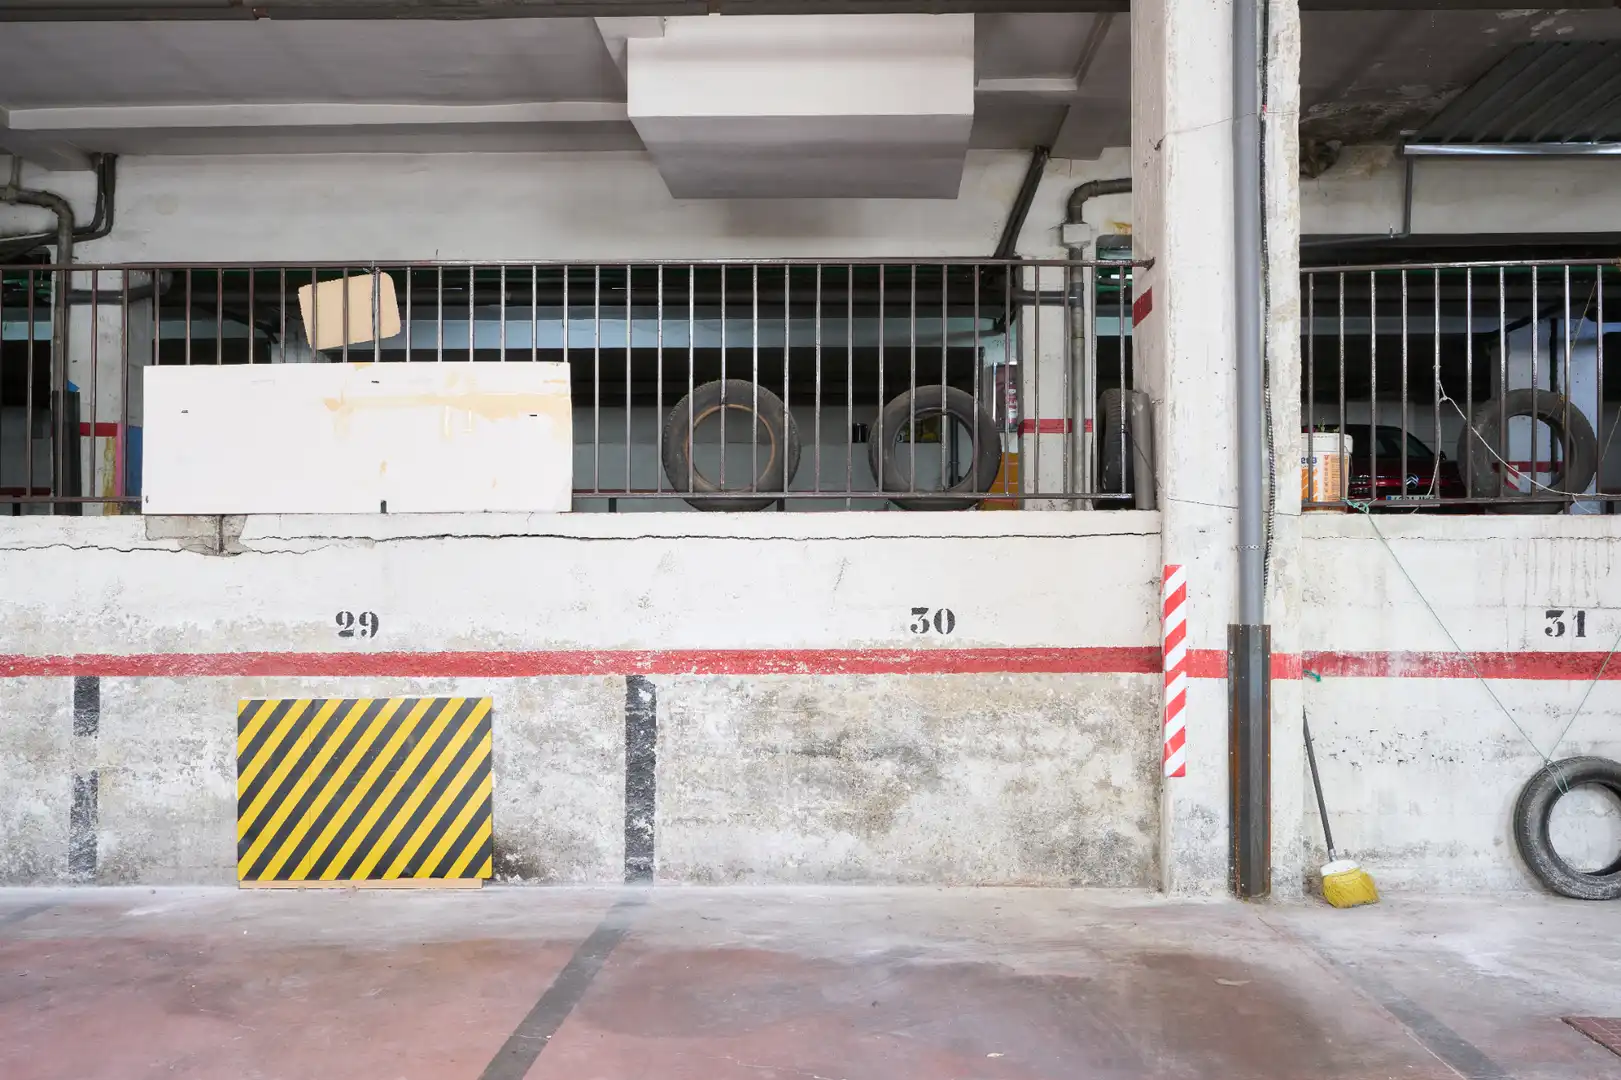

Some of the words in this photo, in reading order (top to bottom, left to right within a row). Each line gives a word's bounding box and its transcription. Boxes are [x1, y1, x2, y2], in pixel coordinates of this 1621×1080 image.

[335, 611, 379, 638] 29
[910, 607, 955, 635] 30
[1544, 610, 1587, 637] 31
